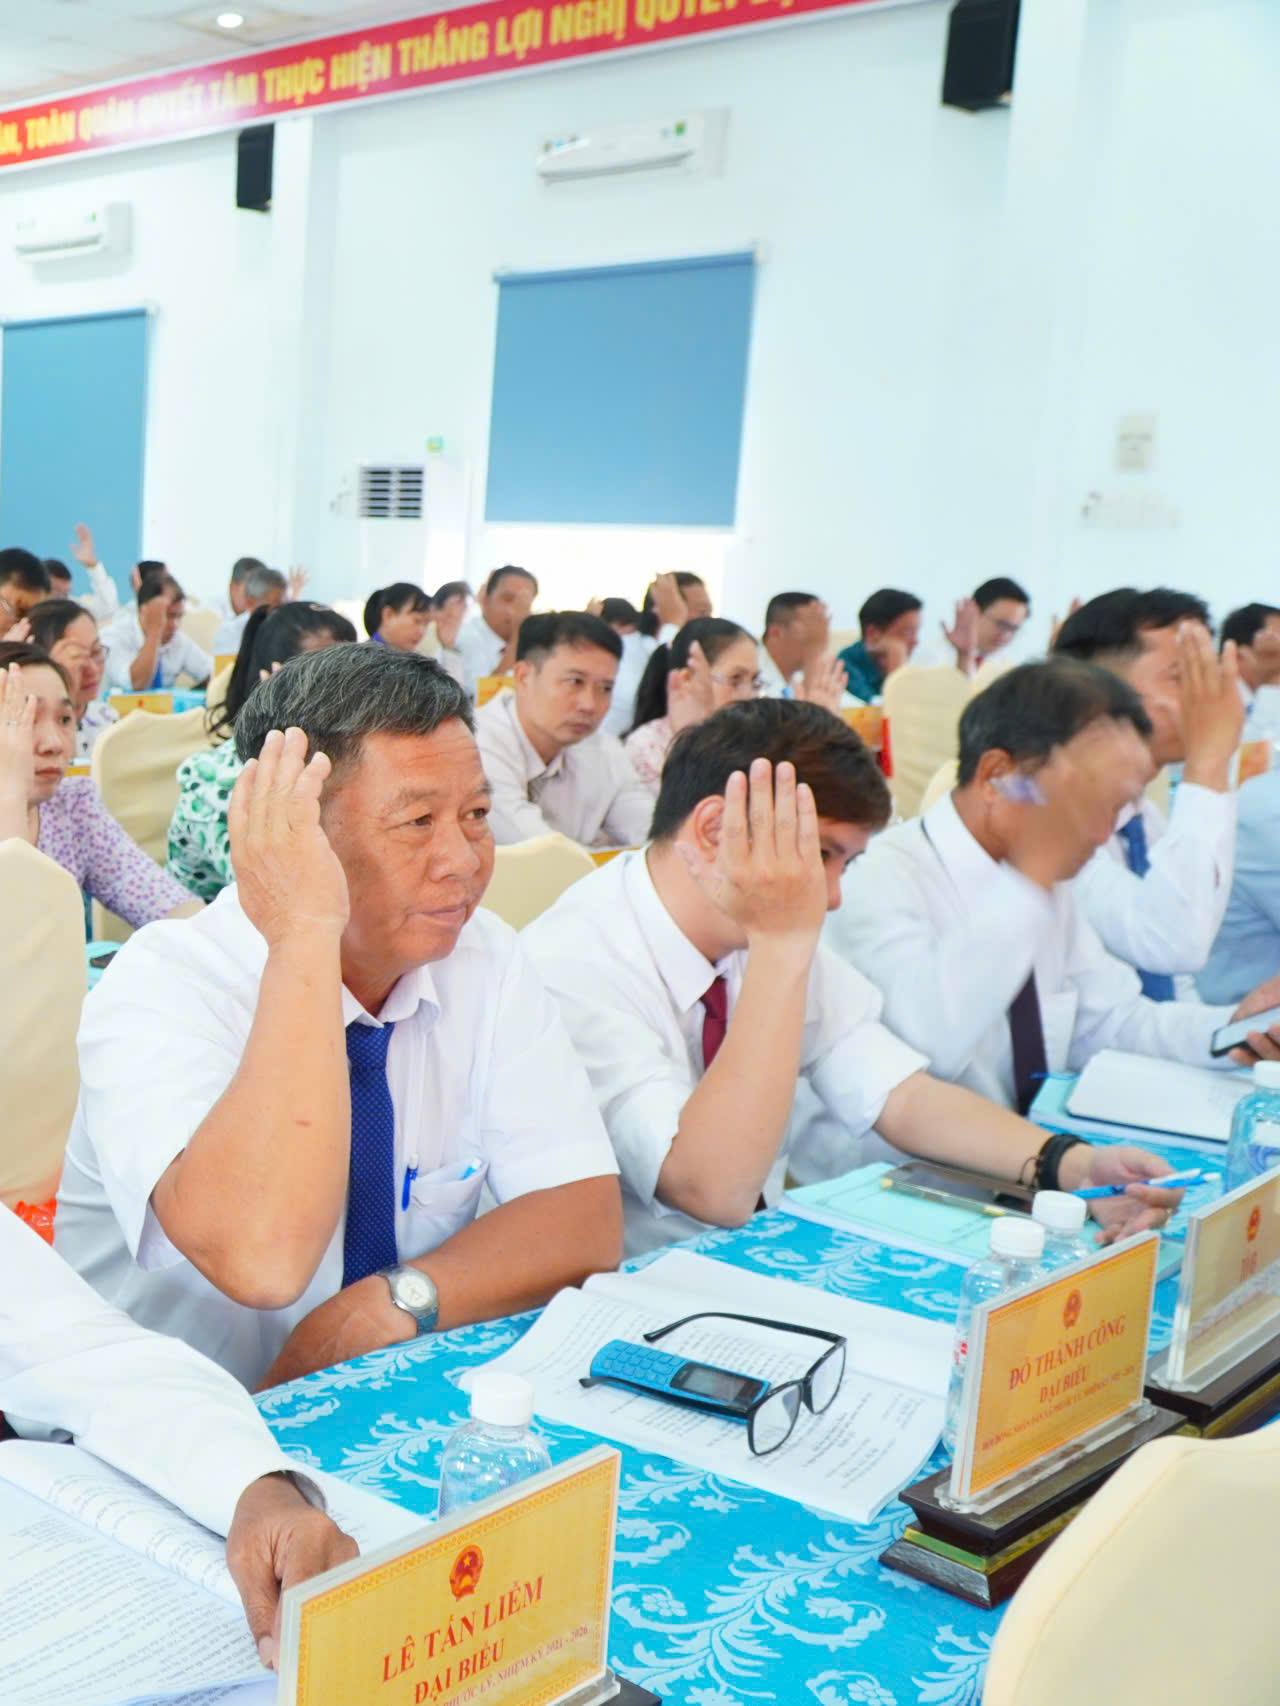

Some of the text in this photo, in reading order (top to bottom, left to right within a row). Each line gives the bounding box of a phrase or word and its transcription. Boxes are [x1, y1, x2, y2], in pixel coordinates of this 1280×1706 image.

[25, 109, 75, 147] TOÀN
[264, 57, 325, 104] THỰC
[330, 40, 392, 92] HIỆN
[397, 18, 488, 75] THẮNG
[495, 8, 543, 59] LỢI
[549, 0, 626, 45] NGHỊ
[1035, 1334, 1085, 1377] THÀNH
[1087, 1314, 1126, 1351] CÔNG
[382, 1633, 416, 1683] LÊ
[414, 1638, 505, 1704] ĐẠI BIỂU
